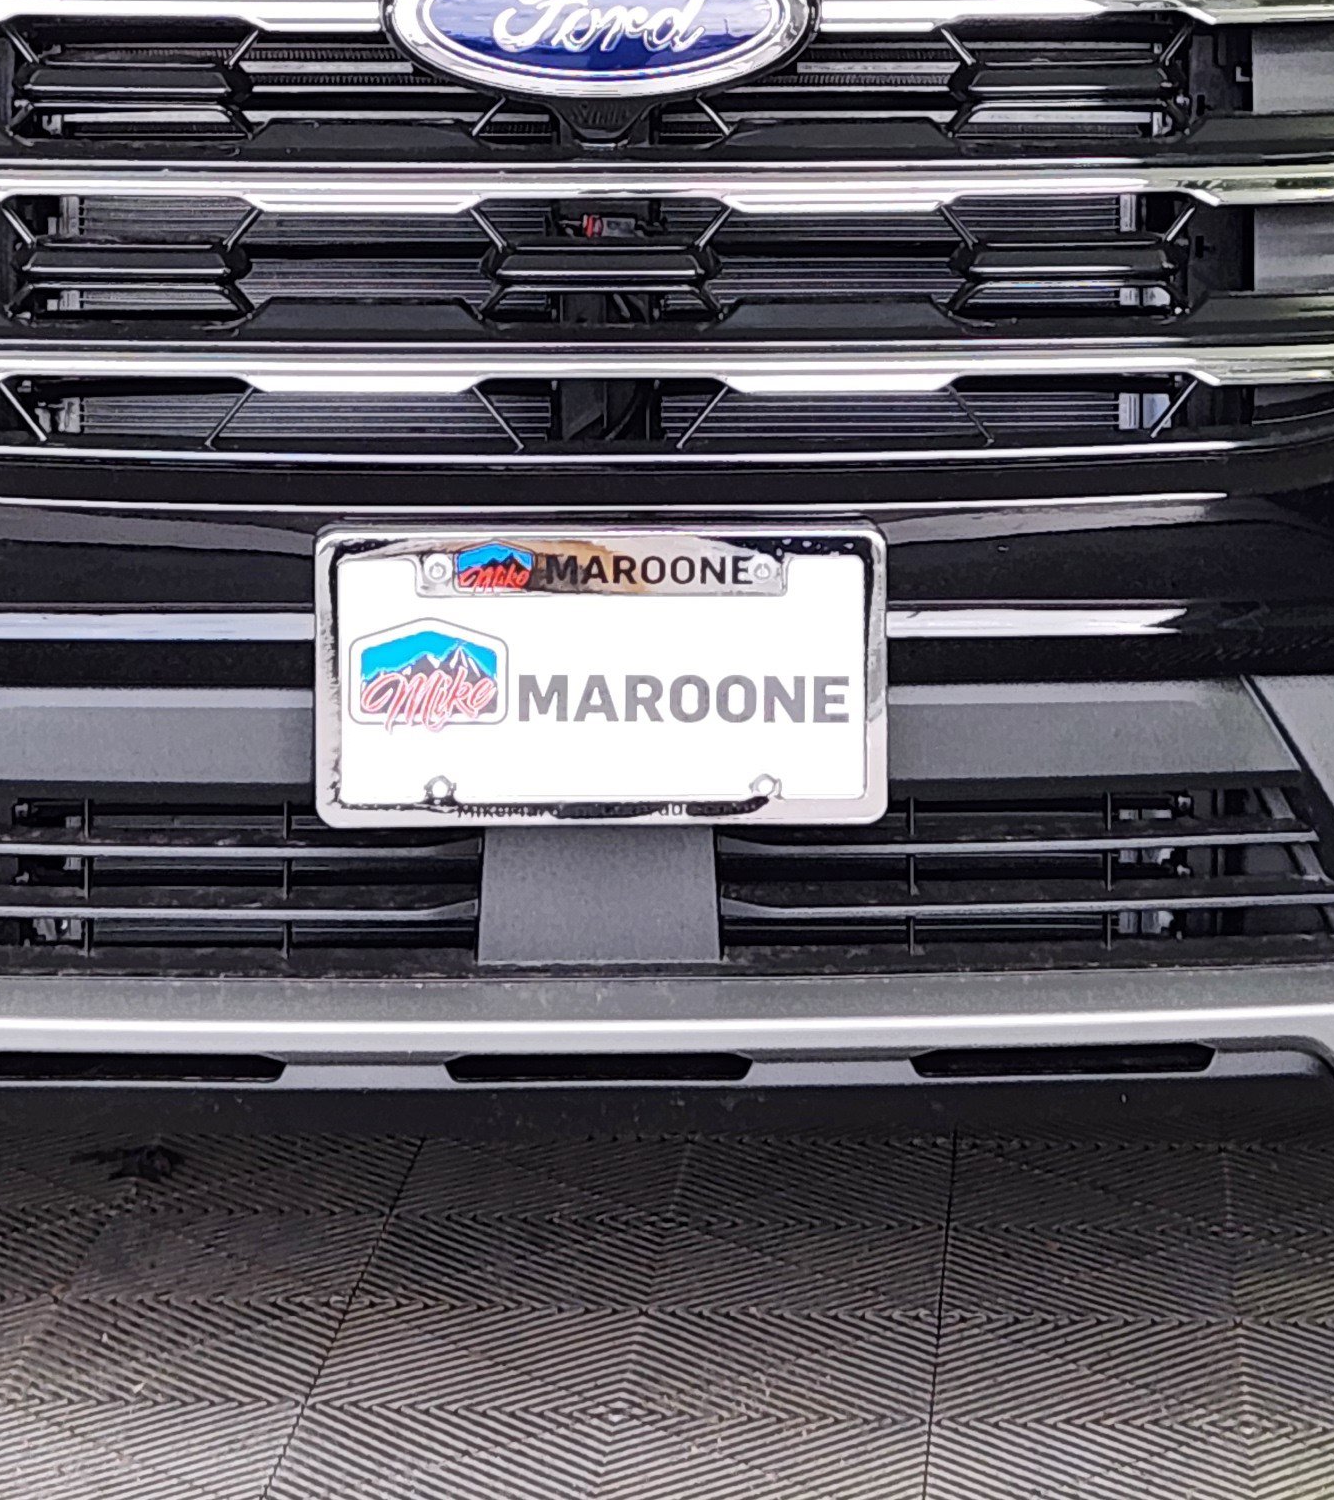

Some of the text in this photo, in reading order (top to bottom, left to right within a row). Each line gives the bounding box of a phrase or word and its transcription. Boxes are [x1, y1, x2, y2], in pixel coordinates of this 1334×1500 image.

[458, 553, 754, 593] Mike MAROONE
[360, 667, 851, 734] Mike MAROONE
